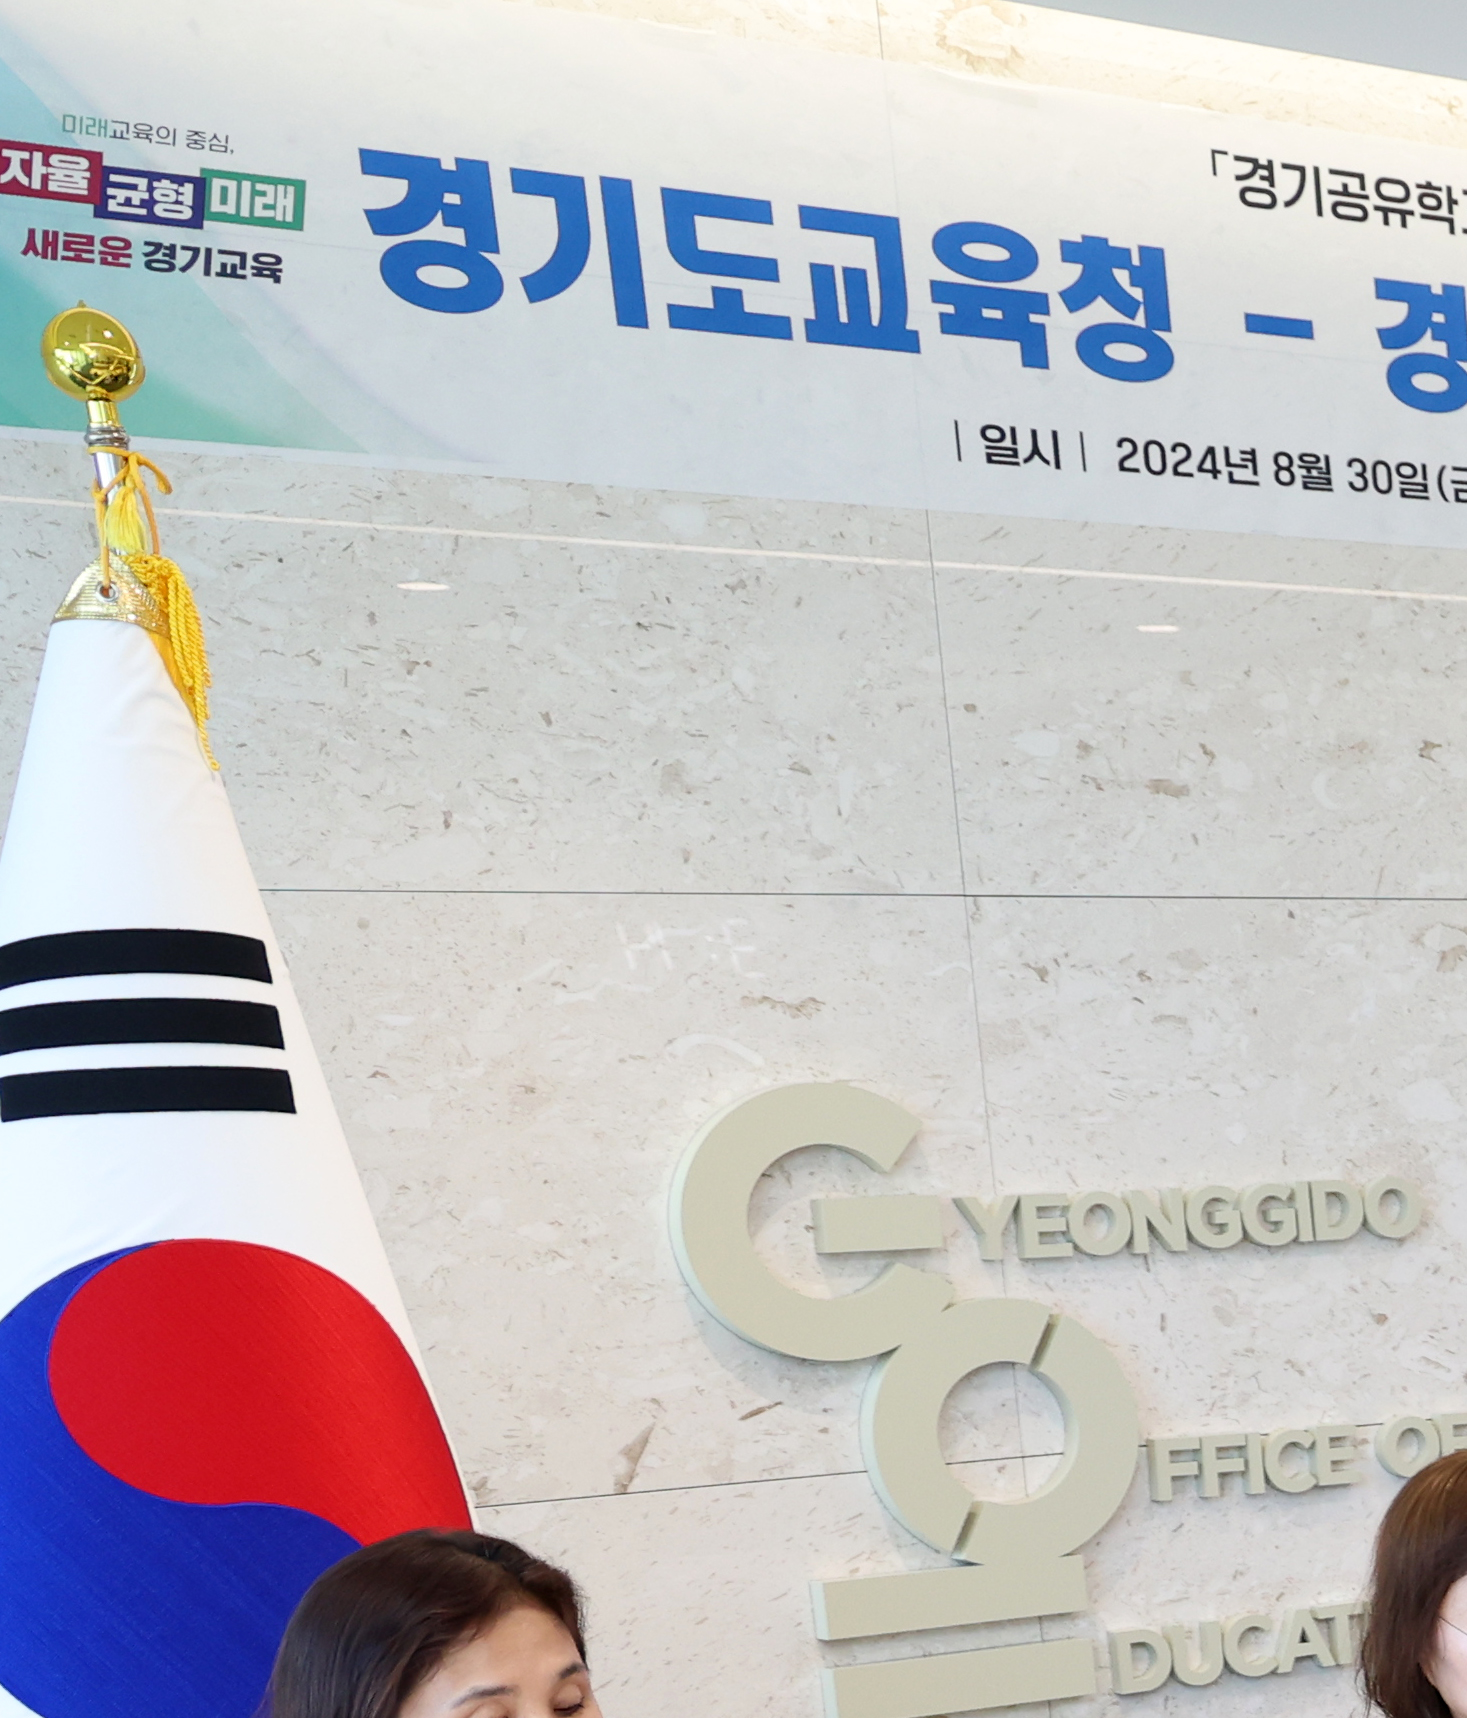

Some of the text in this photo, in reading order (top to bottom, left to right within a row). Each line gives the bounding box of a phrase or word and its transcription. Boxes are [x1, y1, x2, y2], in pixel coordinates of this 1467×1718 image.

[62, 114, 235, 154] 미래교육의 중심,
[0, 148, 295, 223] 자율 균형 미래
[20, 227, 284, 284] 새로운 경기교육
[358, 147, 1176, 383] 경기도교육청
[980, 424, 1062, 470] 일시
[1116, 437, 1260, 487] 2024년
[1273, 451, 1334, 493] 8월
